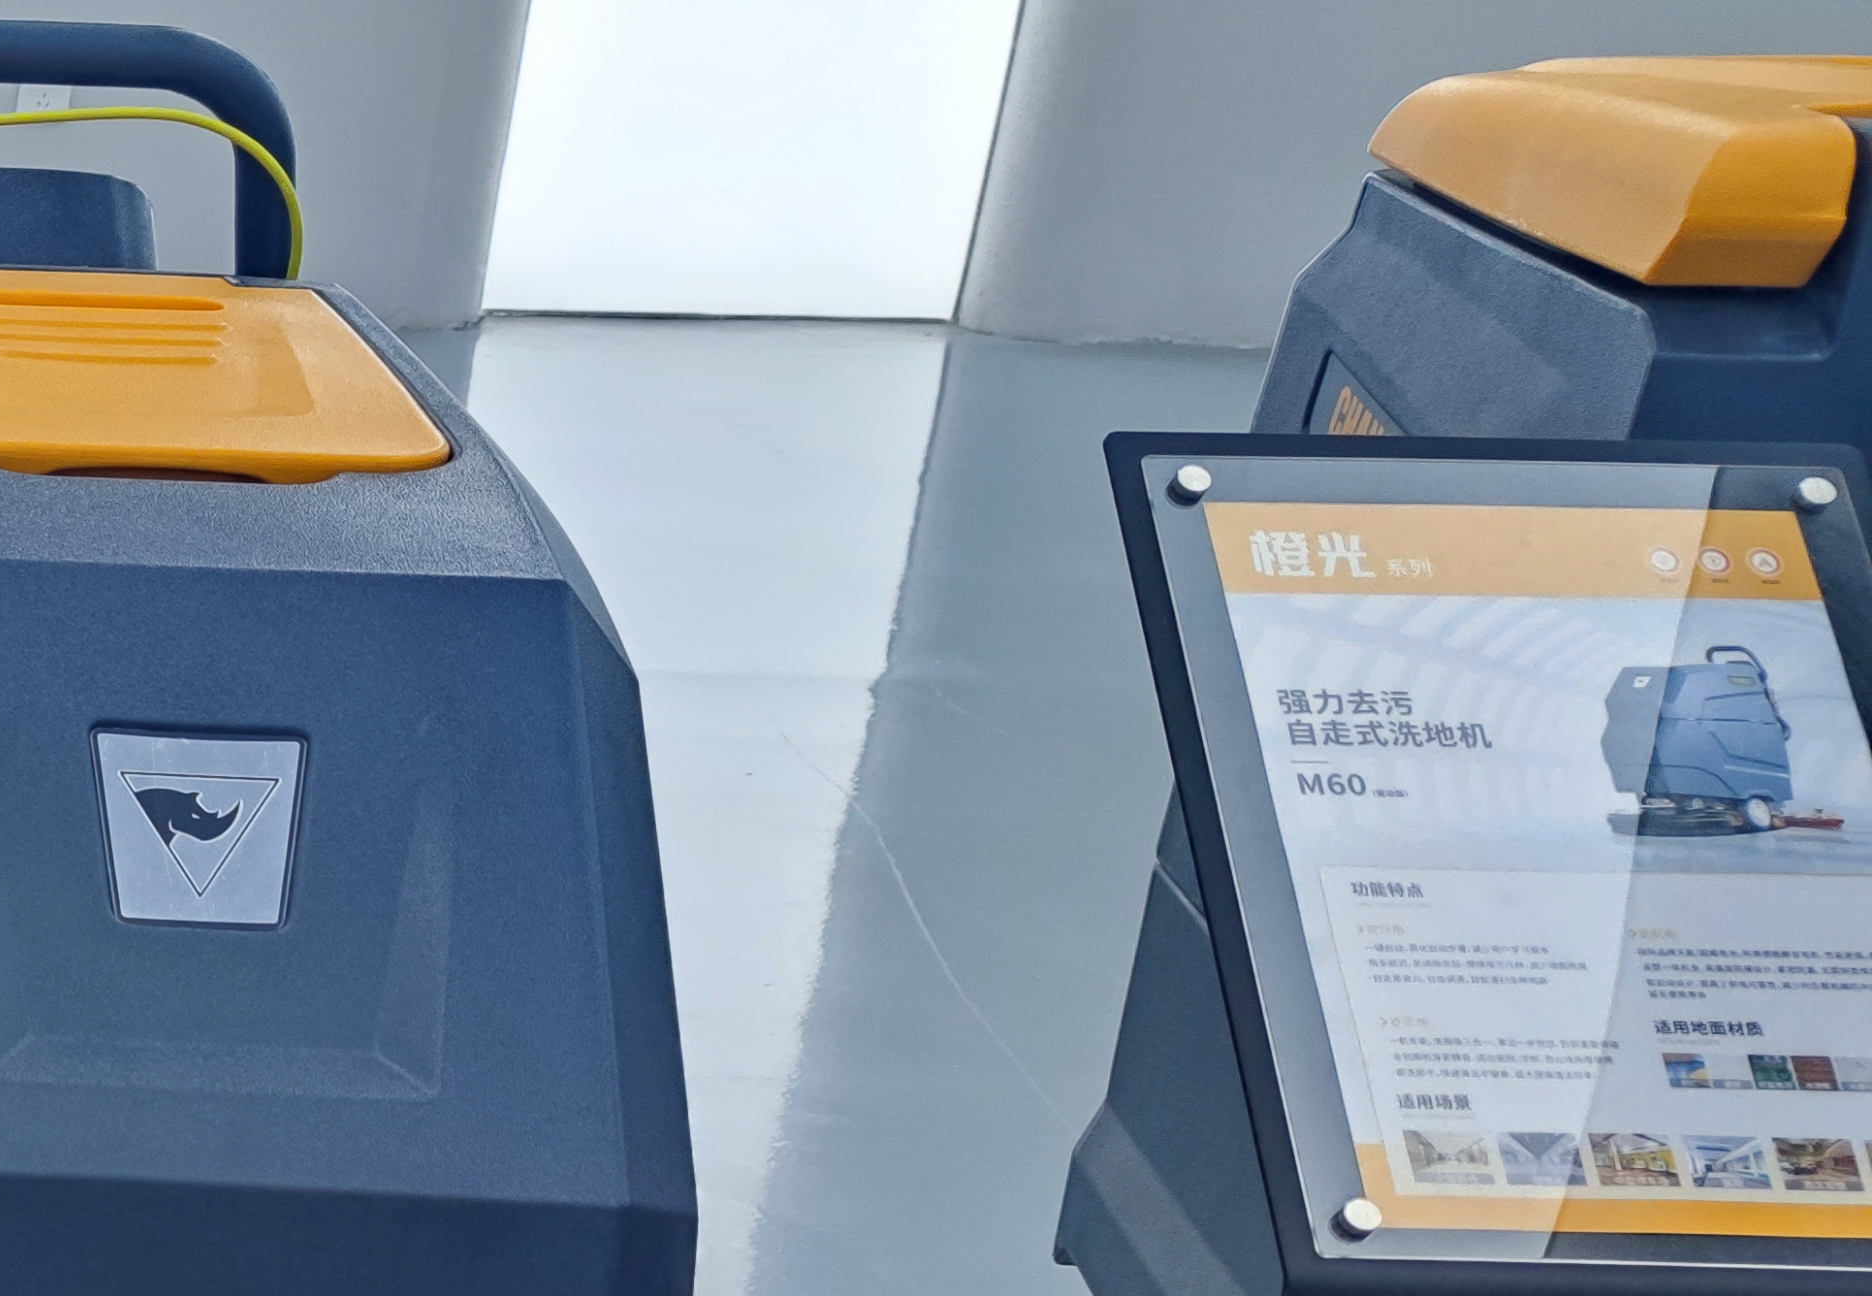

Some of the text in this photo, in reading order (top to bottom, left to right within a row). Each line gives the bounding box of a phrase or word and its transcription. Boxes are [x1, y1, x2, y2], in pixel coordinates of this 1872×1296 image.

[1248, 529, 1435, 579] 橙光 系列
[1276, 688, 1414, 716] 强力去污
[1286, 718, 1494, 749] 自走式洗地机
[1296, 772, 1367, 796] M60
[1350, 880, 1425, 899] 功能特点
[1652, 1019, 1766, 1037] 适用地面材质
[1395, 1093, 1473, 1112] 适用场景
